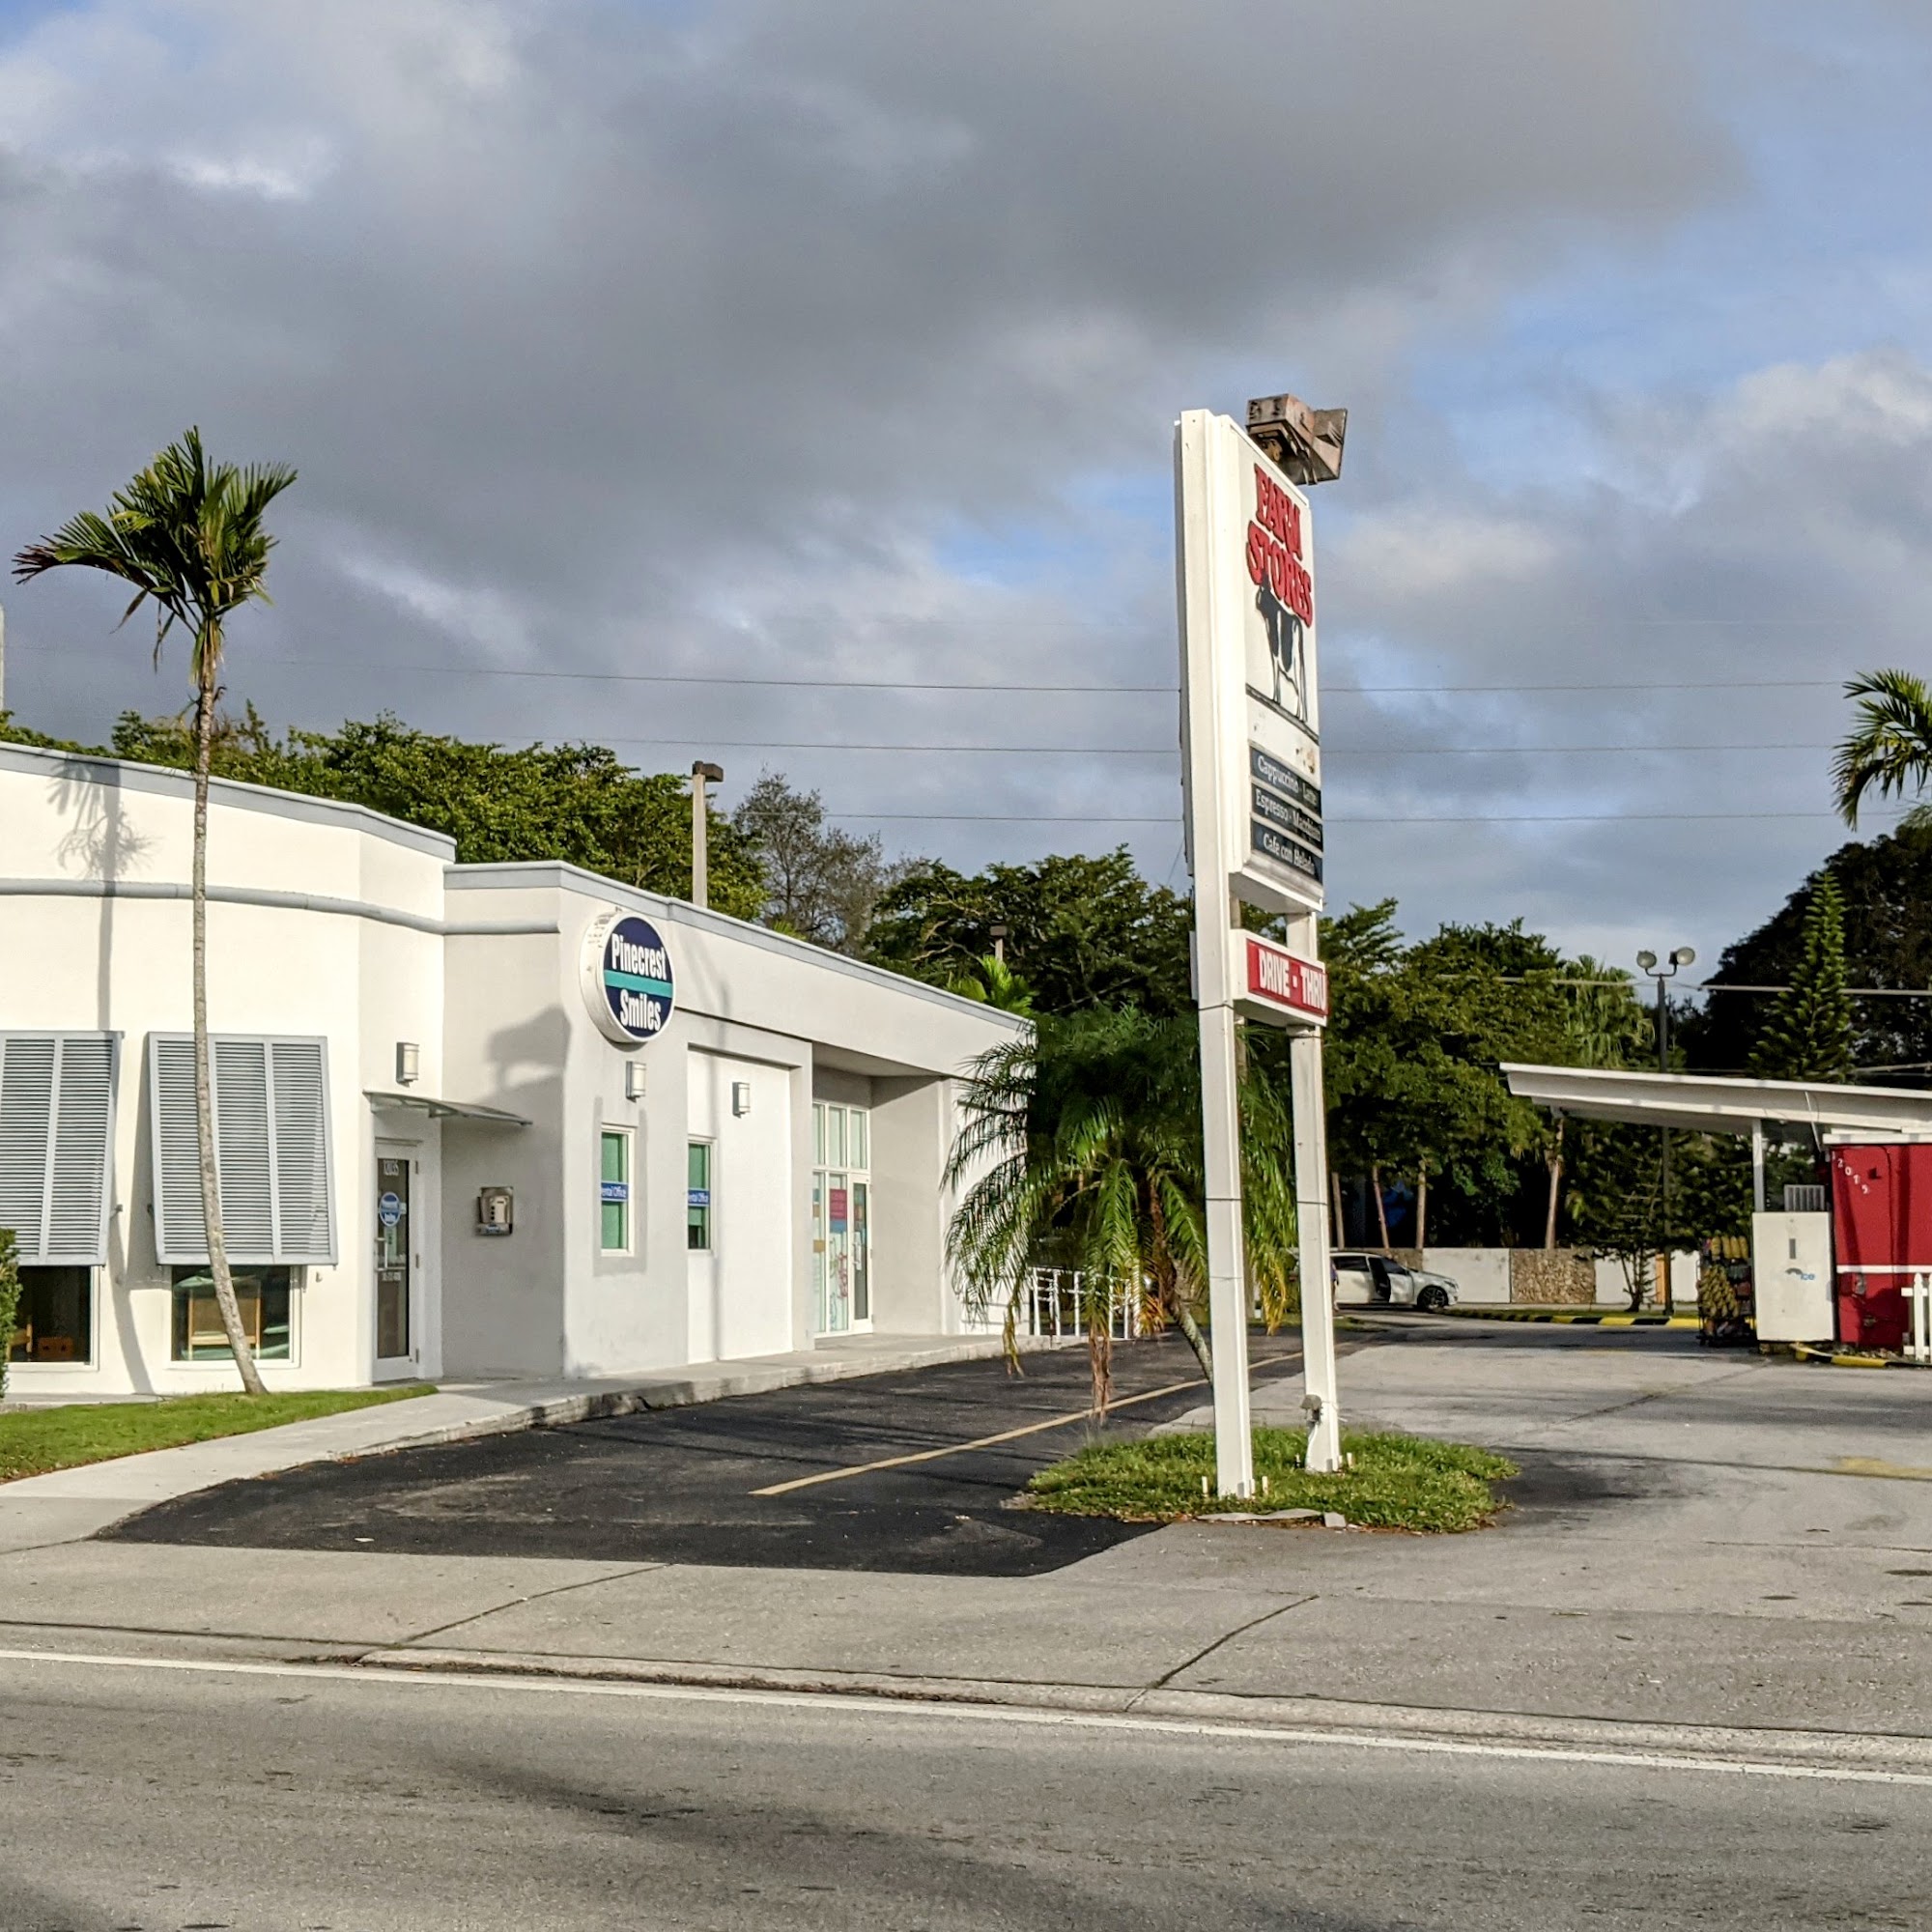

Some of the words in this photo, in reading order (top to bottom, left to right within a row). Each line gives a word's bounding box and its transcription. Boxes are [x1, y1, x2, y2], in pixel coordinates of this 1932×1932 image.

[1253, 463, 1303, 561] FARM
[1246, 520, 1313, 629] STORES
[1256, 788, 1289, 821] Espresso
[611, 932, 668, 981] Pinecrest
[1258, 948, 1291, 999] DRIVE
[1299, 965, 1328, 1012] THRU
[619, 988, 662, 1032] Smiles
